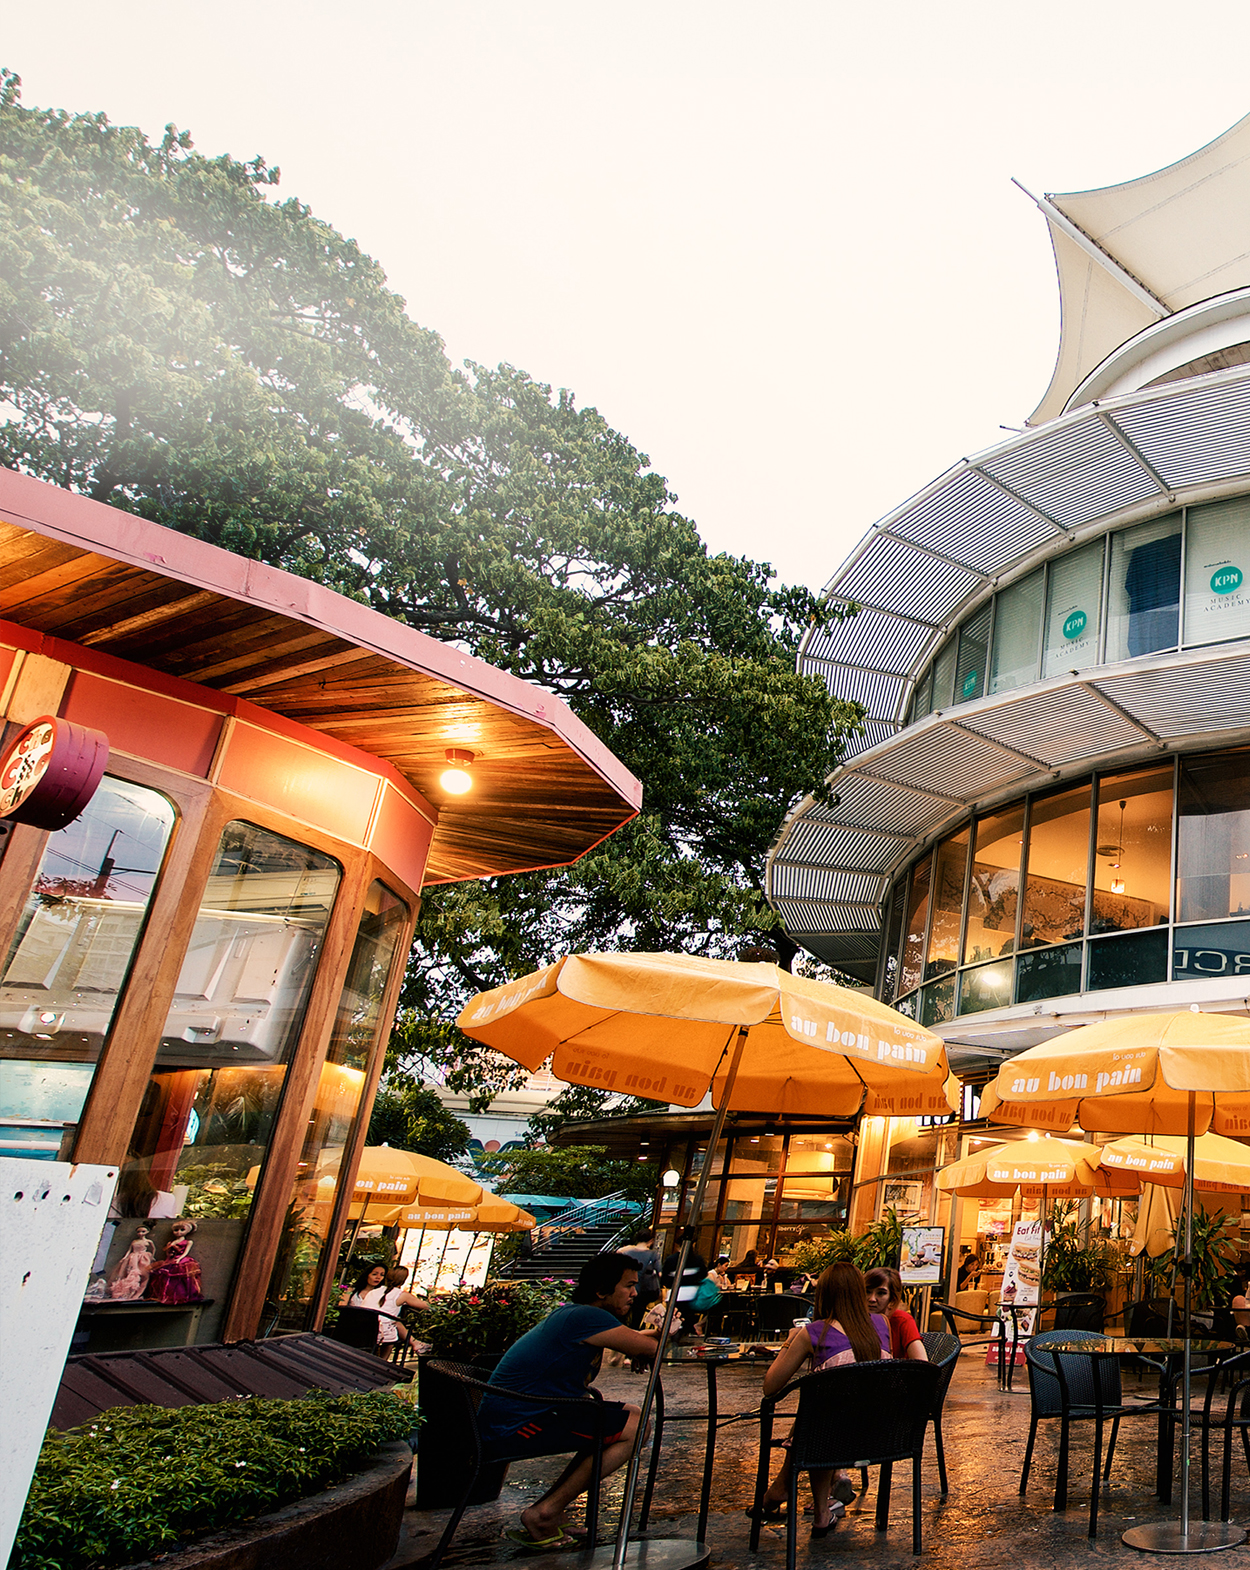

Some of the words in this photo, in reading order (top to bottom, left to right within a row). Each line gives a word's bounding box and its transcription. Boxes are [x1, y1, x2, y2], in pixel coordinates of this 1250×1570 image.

[1215, 573, 1238, 586] KPN
[1204, 598, 1250, 612] ACADEMY
[1210, 594, 1241, 603] MUSIC
[1066, 617, 1083, 631] KPN
[791, 1015, 818, 1037] au
[825, 1021, 869, 1051] bon
[877, 1040, 927, 1064] pain
[1011, 1077, 1040, 1093] au
[1048, 1071, 1088, 1092] bon
[1095, 1064, 1142, 1093] pain
[1107, 1153, 1123, 1164] au
[1125, 1155, 1147, 1167] bon
[1148, 1158, 1175, 1170] pain
[993, 1169, 1010, 1179] au
[1013, 1168, 1036, 1179] bon
[1040, 1169, 1067, 1181] pain
[355, 1180, 374, 1189] on
[376, 1181, 407, 1192] pain
[424, 1212, 445, 1220] bon
[447, 1211, 471, 1221] pain
[1017, 1227, 1029, 1235] Eat
[1031, 1227, 1041, 1235] Fit
